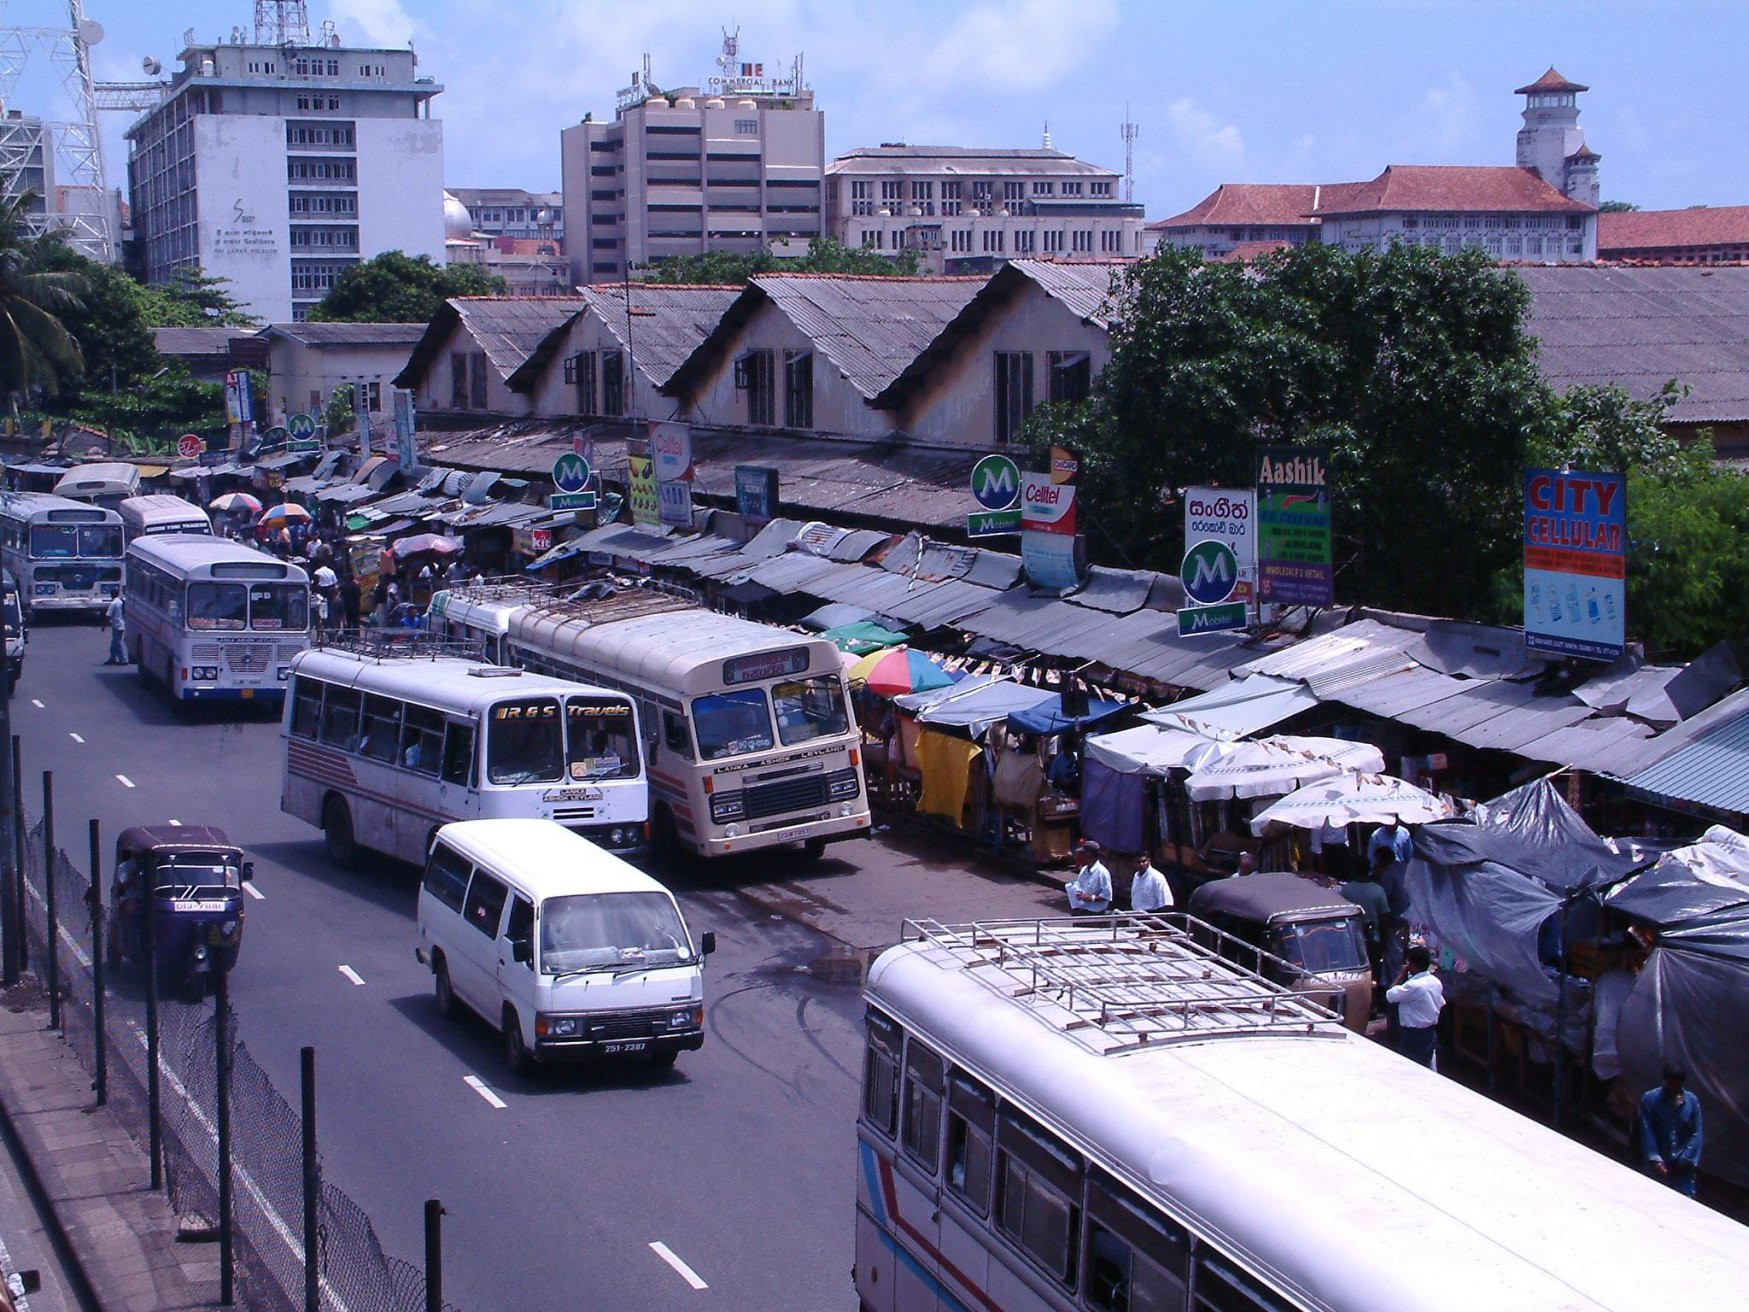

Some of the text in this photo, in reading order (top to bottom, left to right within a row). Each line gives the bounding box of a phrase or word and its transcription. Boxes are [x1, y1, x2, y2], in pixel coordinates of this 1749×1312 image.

[708, 77, 764, 86] COMMERCIAL
[980, 466, 1013, 498] M
[1259, 456, 1325, 485] Aashik
[1026, 484, 1060, 504] Celltel
[1530, 476, 1618, 516] CITY
[533, 535, 550, 549] kit
[1527, 515, 1621, 552] CELLULAR
[1190, 552, 1229, 591] M
[542, 705, 556, 718] S
[567, 705, 631, 717] Travels
[717, 746, 843, 773] LANKA ASHOK LEYLAND
[560, 788, 586, 796] LANKA
